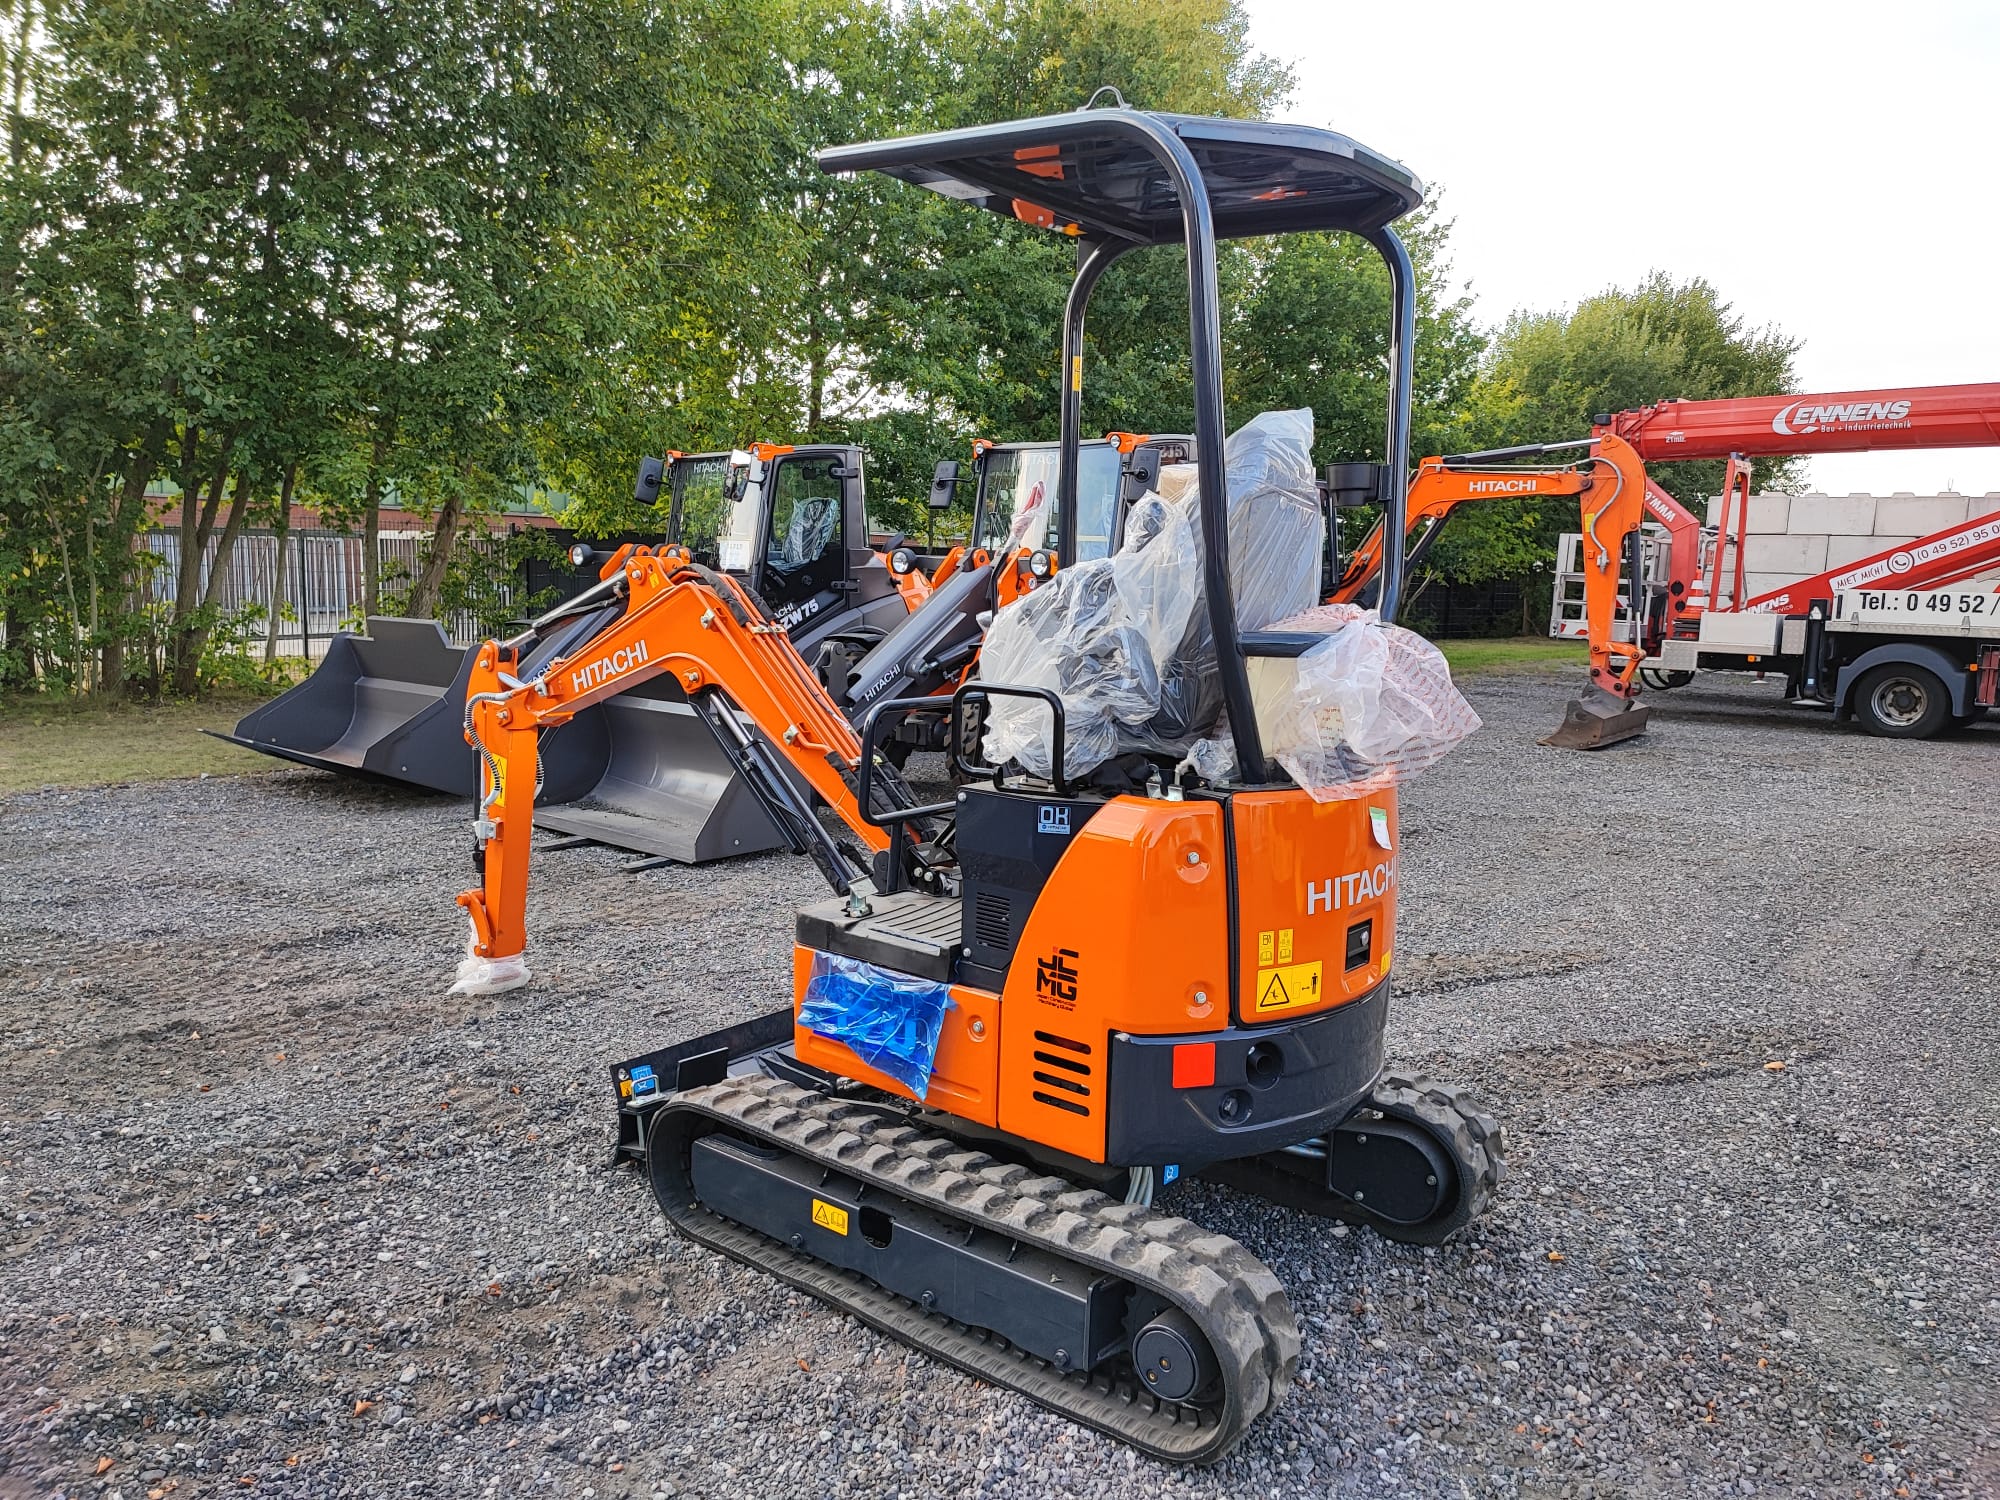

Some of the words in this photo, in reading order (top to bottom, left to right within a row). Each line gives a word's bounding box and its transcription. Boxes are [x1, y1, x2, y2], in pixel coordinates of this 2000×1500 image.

[1821, 424, 1836, 432] Bau
[1845, 420, 1911, 432] Industrietechnik
[694, 462, 727, 473] HITACHI
[1469, 479, 1537, 492] HITACHI
[1932, 543, 1947, 554] 49
[1950, 534, 1970, 549] 52)
[1972, 529, 1989, 541] 95
[1837, 573, 1858, 588] MIET
[1861, 565, 1885, 580] MICH!
[1860, 592, 1898, 611] Tel.:
[1906, 593, 1919, 612] 0
[1925, 594, 1951, 612] 49
[1958, 595, 1985, 614] 52
[572, 639, 649, 693] HITACHI
[864, 663, 901, 702] HITACHI
[1040, 806, 1069, 825] OK
[1307, 855, 1397, 915] HITACHI
